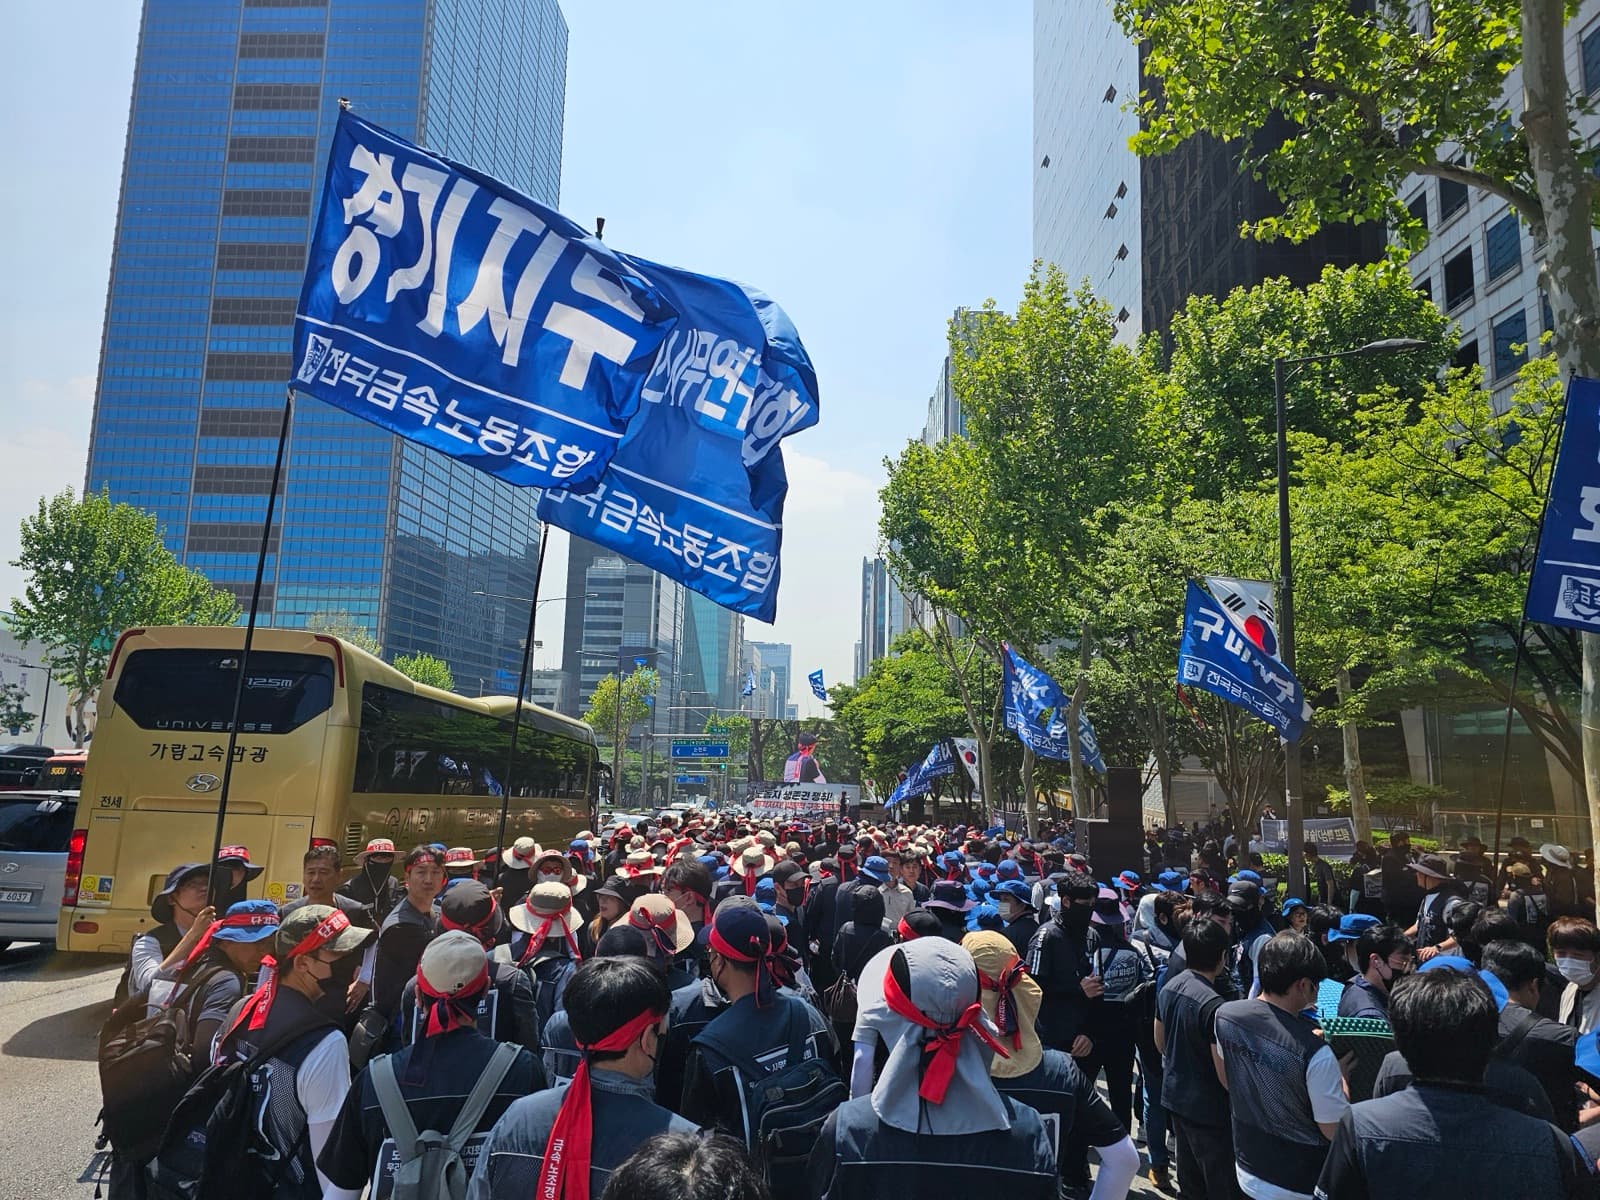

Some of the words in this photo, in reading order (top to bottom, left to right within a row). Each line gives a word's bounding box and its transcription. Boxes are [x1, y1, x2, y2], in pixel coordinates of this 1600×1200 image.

[319, 348, 596, 478] 전국금속노동조합
[546, 483, 778, 594] 국금속노동조합
[157, 720, 272, 731] UNIVERSE
[100, 796, 122, 808] 전세
[7, 892, 28, 901] 6037
